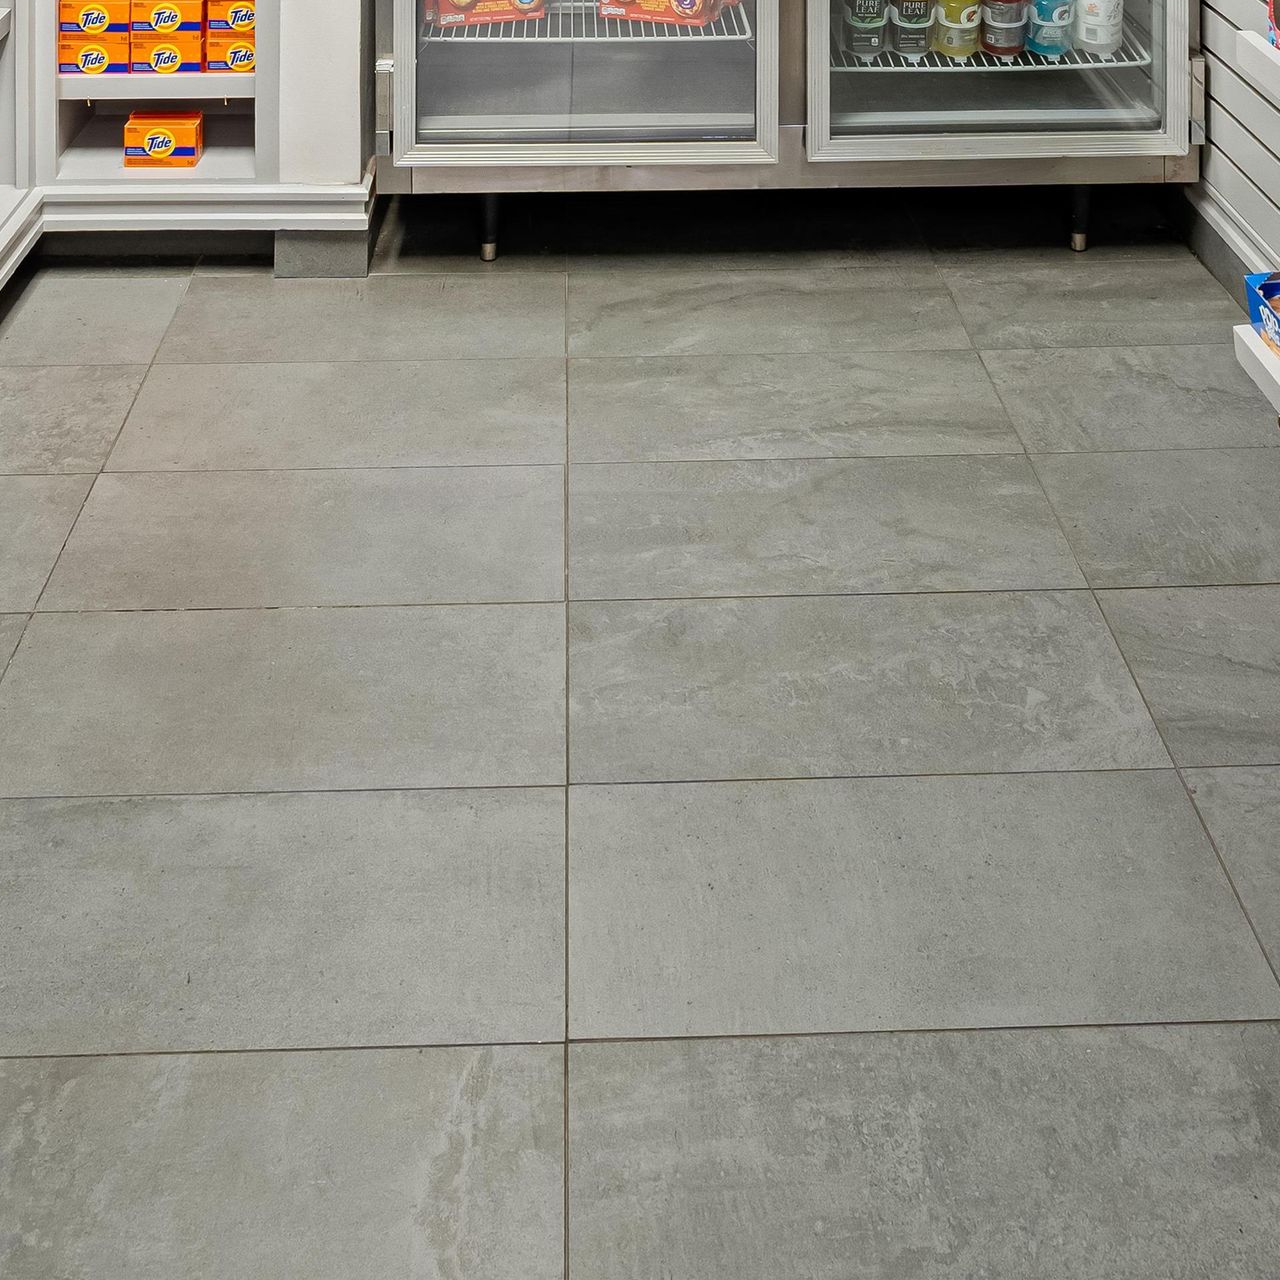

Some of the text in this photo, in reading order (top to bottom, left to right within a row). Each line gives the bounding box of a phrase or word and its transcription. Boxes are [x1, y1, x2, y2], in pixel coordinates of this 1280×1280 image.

[82, 12, 106, 28] Tide
[153, 11, 178, 27] Tide
[147, 136, 172, 152] Tide
